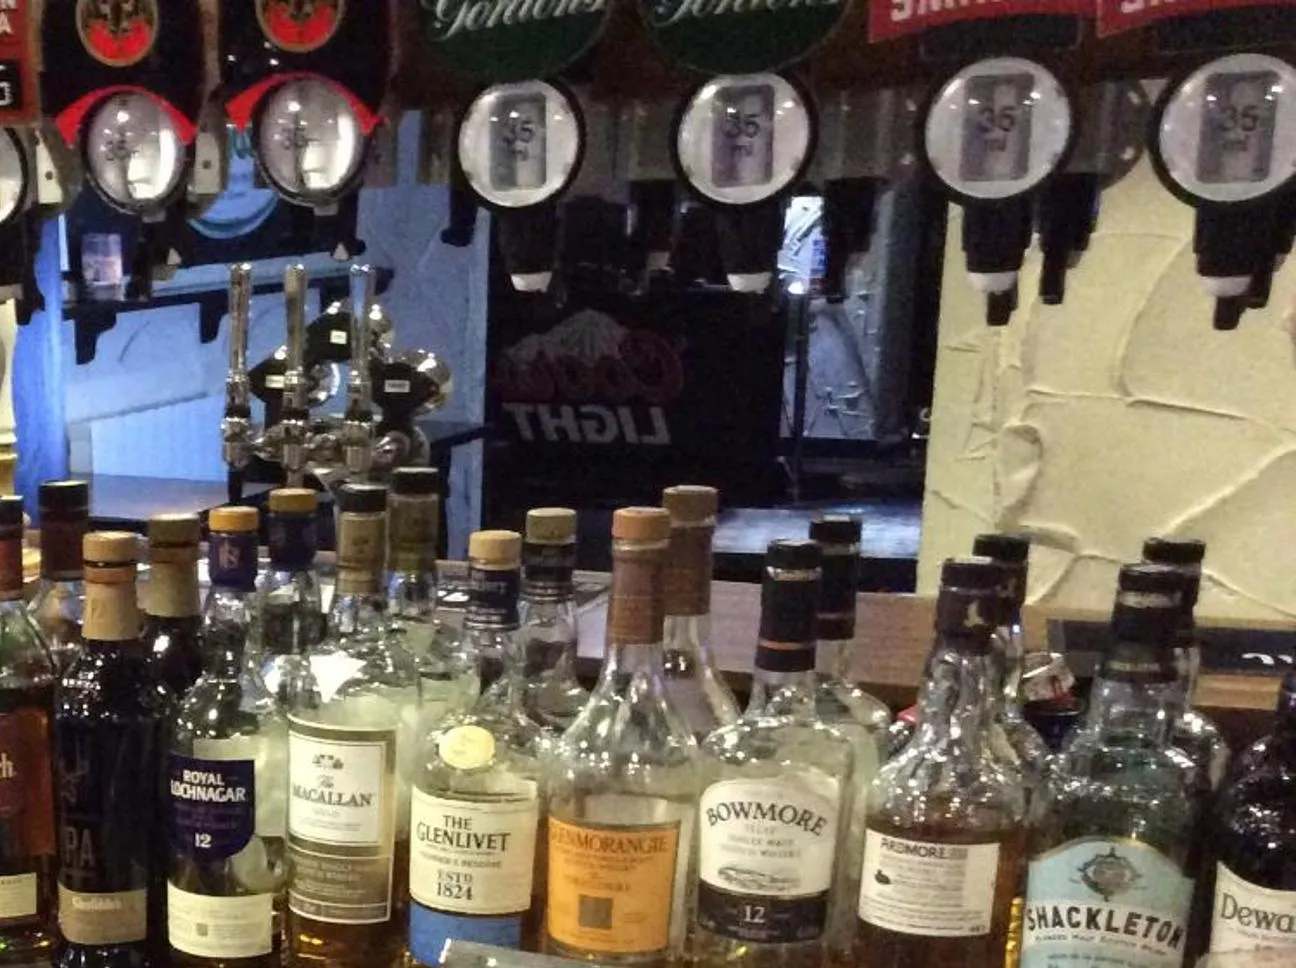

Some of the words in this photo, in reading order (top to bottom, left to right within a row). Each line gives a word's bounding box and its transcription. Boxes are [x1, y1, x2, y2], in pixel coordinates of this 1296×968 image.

[183, 769, 225, 786] ROYAL
[442, 814, 473, 830] THE
[706, 801, 828, 837] BOWMORE
[194, 832, 212, 849] 12
[416, 821, 512, 852] GLENLIVET
[436, 882, 474, 901] 1824
[742, 904, 766, 923] 12
[1220, 892, 1296, 934] Dewa
[1026, 905, 1186, 949] SHACKLETON
